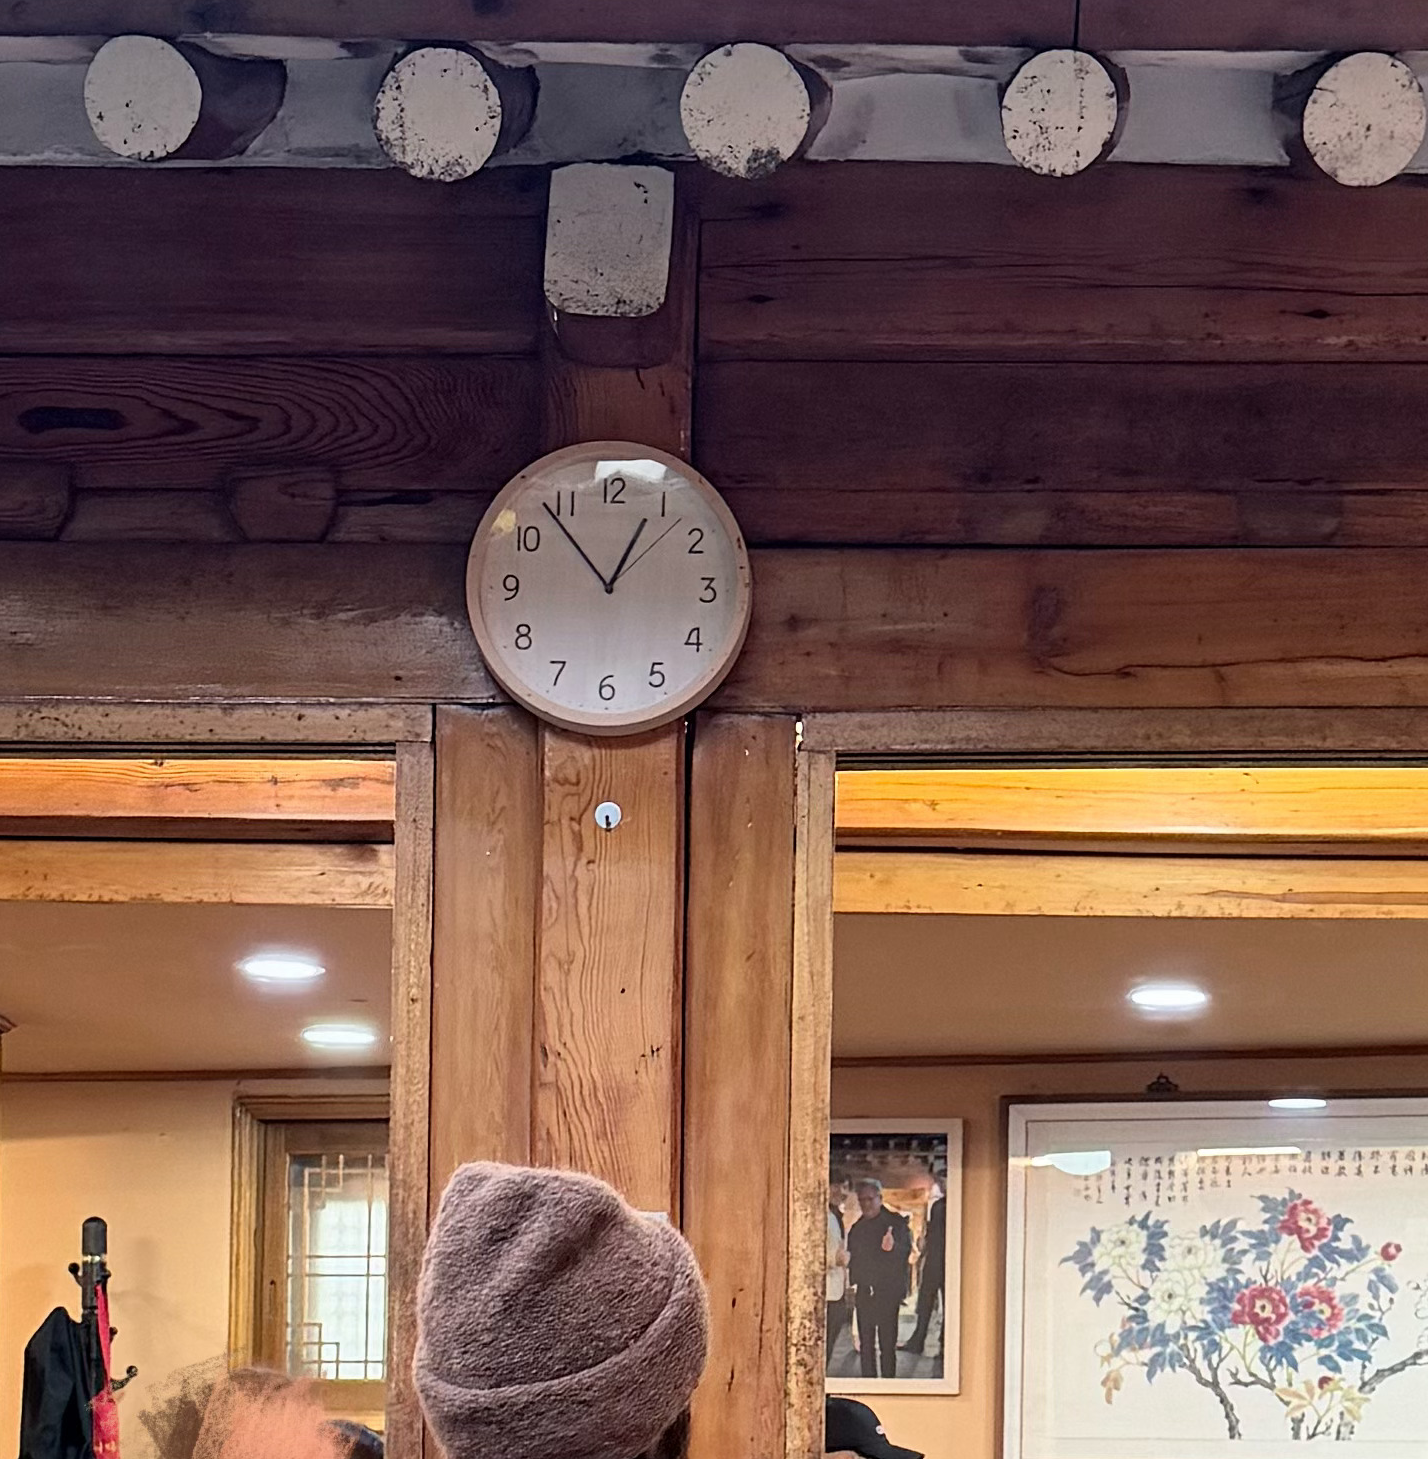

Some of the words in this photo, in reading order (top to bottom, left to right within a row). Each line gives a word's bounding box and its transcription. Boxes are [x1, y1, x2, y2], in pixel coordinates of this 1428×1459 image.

[556, 490, 575, 517] 11
[604, 478, 626, 504] 12
[660, 491, 667, 518] 1
[517, 526, 540, 552] 10
[688, 528, 704, 554] 2
[503, 575, 519, 601] 9
[699, 577, 717, 603] 3
[515, 624, 532, 650] 8
[684, 627, 703, 652] 4
[549, 661, 566, 686] 7
[649, 662, 665, 688] 5
[599, 675, 615, 701] 6
